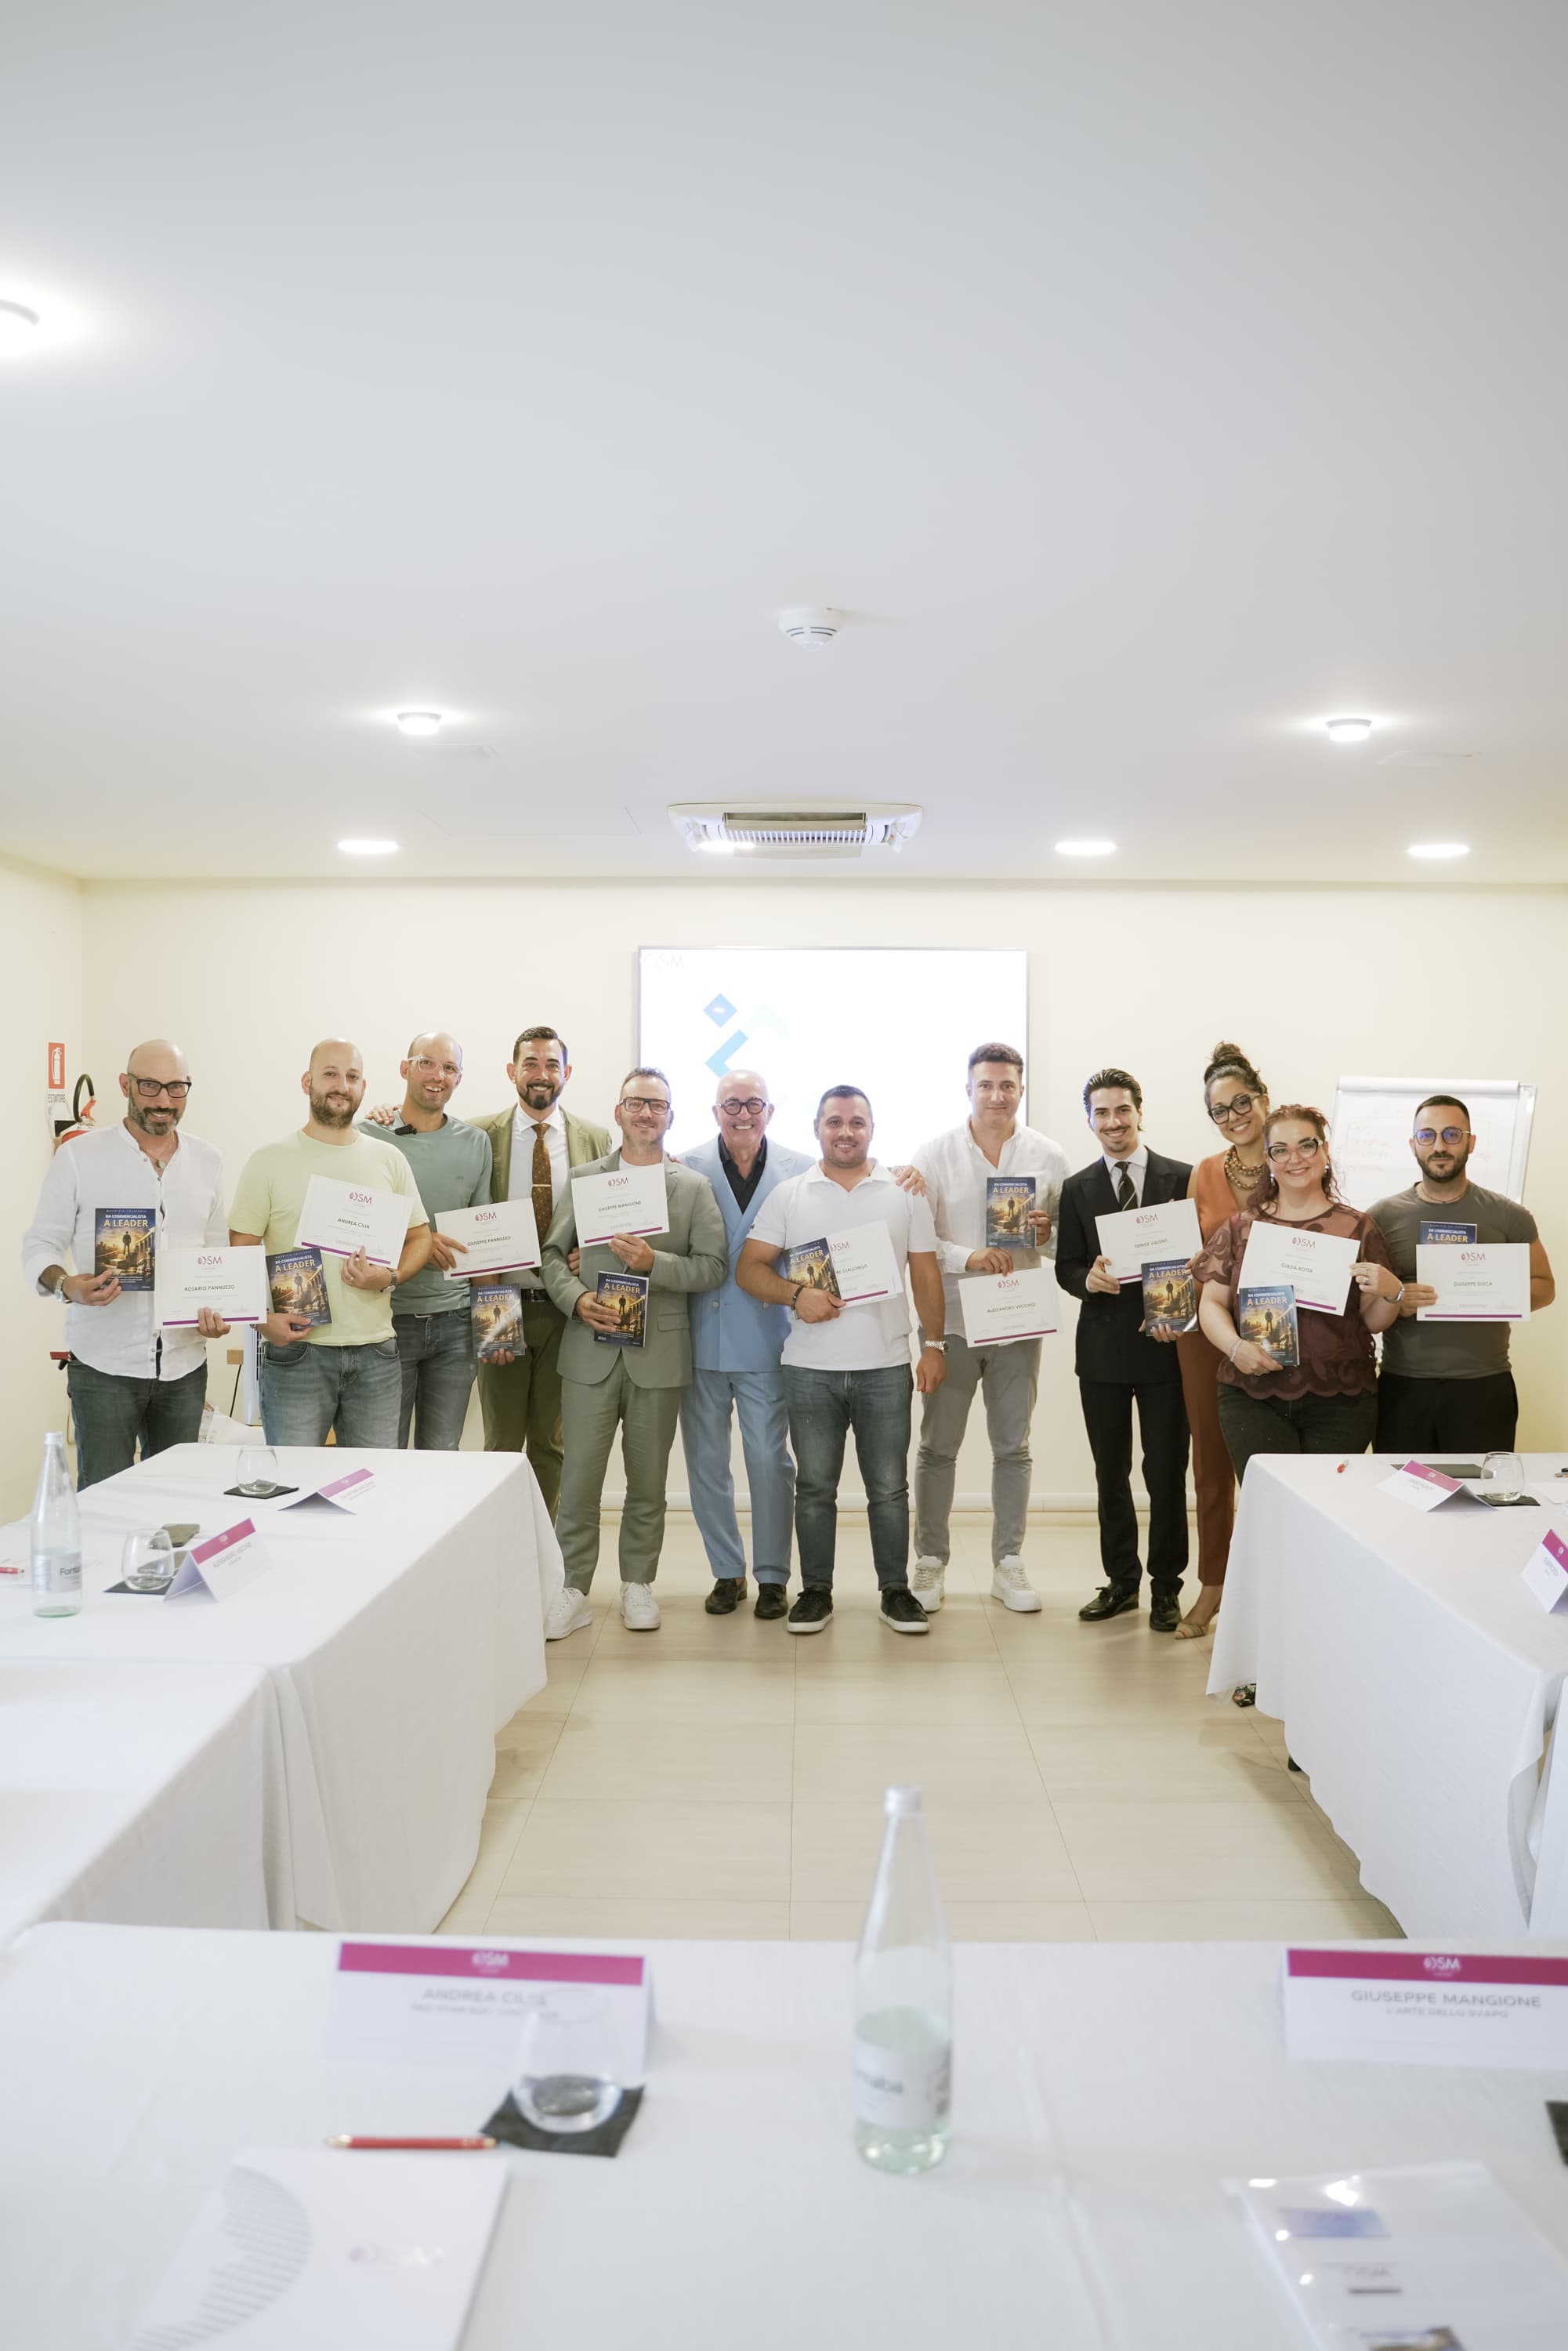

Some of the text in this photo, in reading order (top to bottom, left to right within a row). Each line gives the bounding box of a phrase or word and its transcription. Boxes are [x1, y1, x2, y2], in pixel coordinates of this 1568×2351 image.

[608, 1177, 629, 1186] OSM
[349, 1192, 373, 1204] OSM
[338, 1218, 357, 1226] ANDREA
[475, 1212, 498, 1222] OSM
[1135, 1213, 1159, 1224] OSM
[1292, 1237, 1316, 1248] OSM
[1436, 1234, 1468, 1243] LEADER
[197, 1255, 223, 1265] OSM
[797, 1249, 824, 1263] LEADER
[283, 1259, 315, 1271] LEADER
[1156, 1269, 1187, 1278] LEADER
[998, 1279, 1019, 1288] OSM
[611, 1284, 640, 1294] LEADER
[1423, 1956, 1461, 1970] OSM
[422, 1988, 496, 2001] ANDREA
[1351, 1989, 1541, 2008] GIUSEPPE MANGIONE
